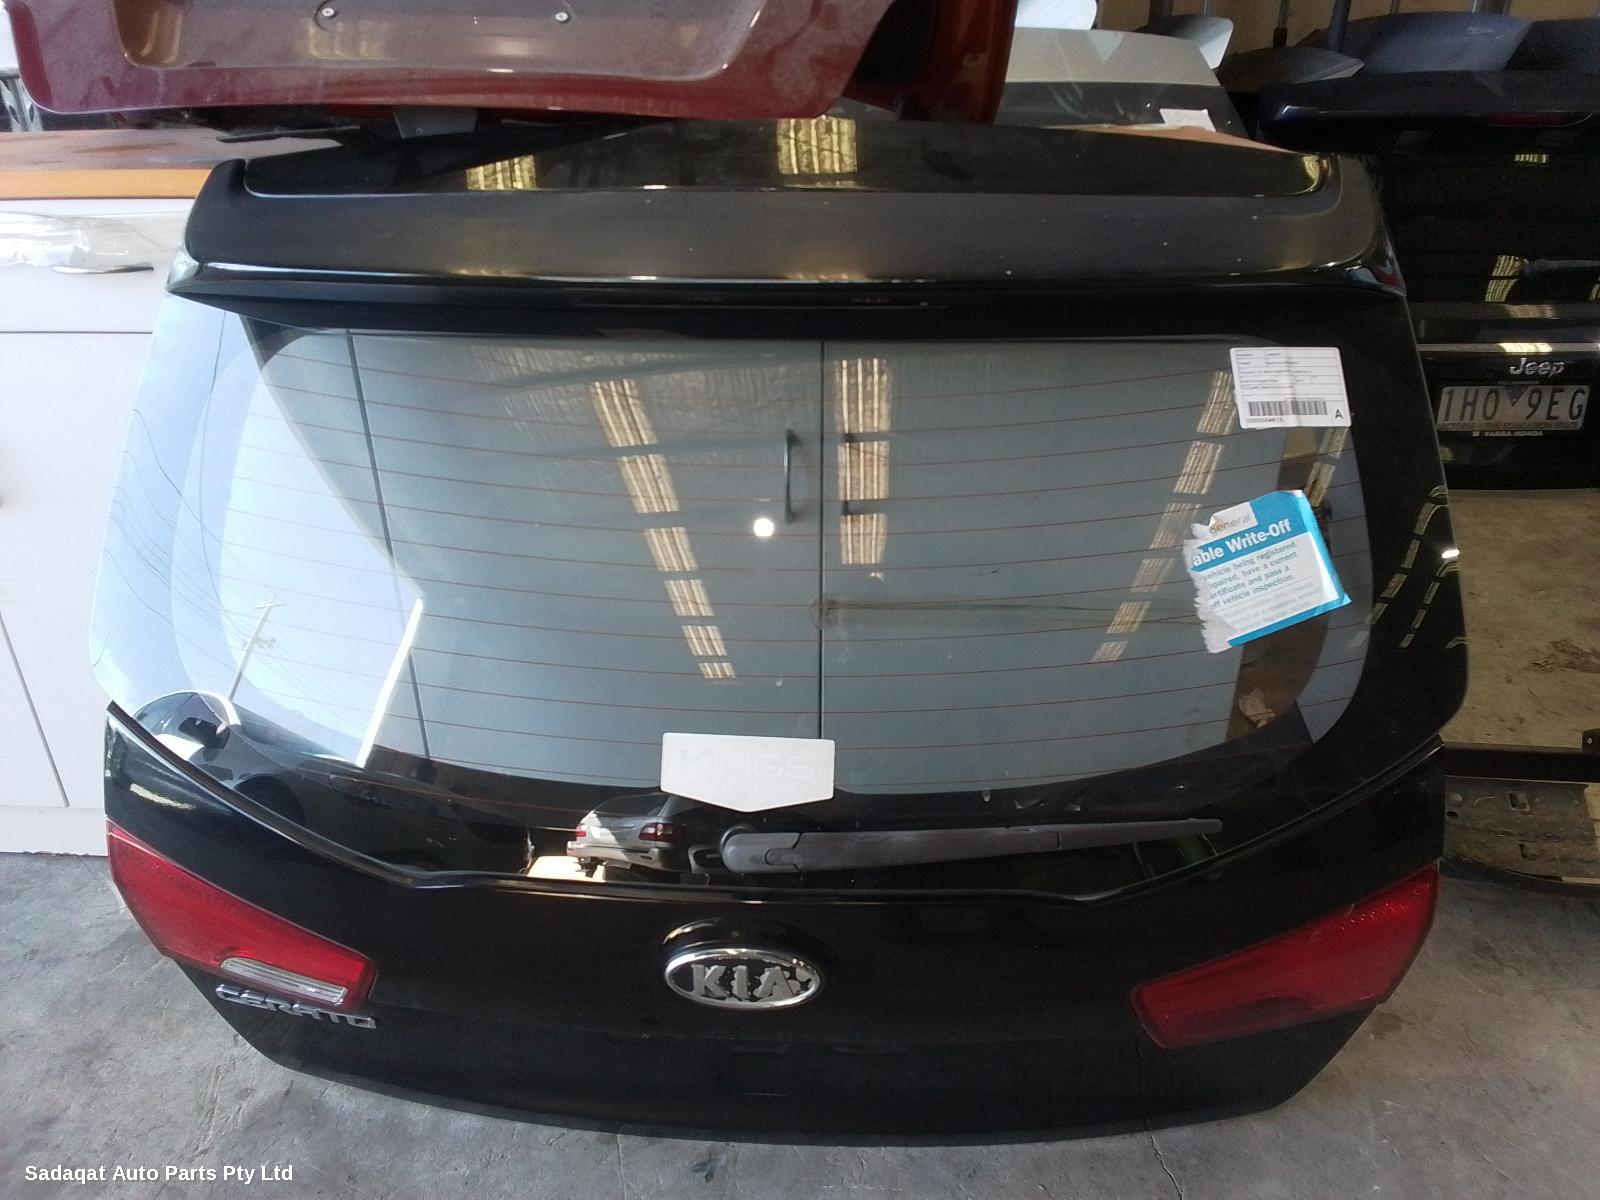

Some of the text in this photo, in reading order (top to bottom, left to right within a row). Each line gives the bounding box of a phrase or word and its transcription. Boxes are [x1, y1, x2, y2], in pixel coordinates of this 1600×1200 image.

[1509, 358, 1565, 378] Jeep
[1335, 408, 1344, 419] A
[1526, 387, 1586, 421] 9EG
[1210, 514, 1251, 536] general
[1192, 518, 1292, 567] able Write-Off
[1241, 566, 1261, 577] have
[1269, 551, 1297, 567] current
[1247, 575, 1263, 586] and
[1222, 590, 1251, 606] vehicle
[690, 963, 794, 1001] KIA
